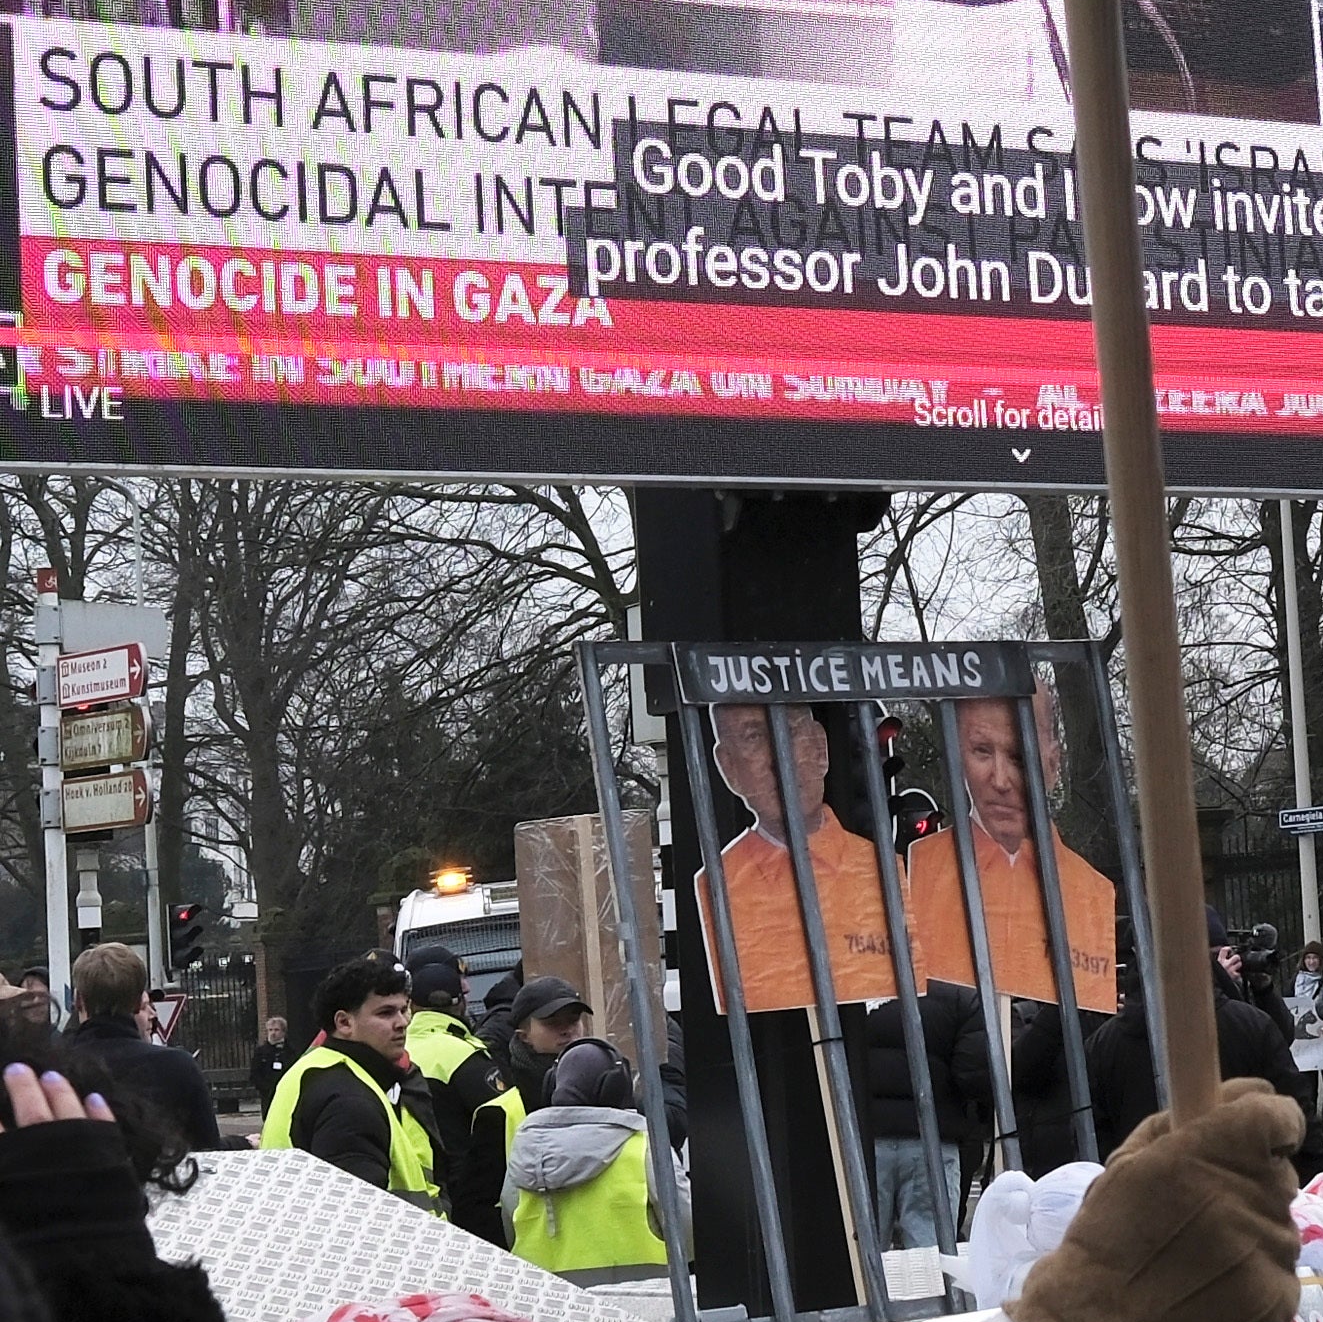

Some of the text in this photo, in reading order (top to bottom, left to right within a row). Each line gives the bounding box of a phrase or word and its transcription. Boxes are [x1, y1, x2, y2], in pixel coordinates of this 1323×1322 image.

[39, 47, 284, 127] SOUTH
[312, 70, 602, 149] AFRICAN
[628, 94, 816, 163] LEGAL
[842, 111, 1001, 179] TEAM
[1027, 126, 1168, 196] SS
[43, 144, 450, 232] GENOCIDAL
[633, 137, 785, 203] Good
[800, 150, 934, 226] Toby
[951, 164, 1045, 219] and
[1065, 167, 1076, 222] I
[1134, 185, 1198, 230] ow
[43, 248, 615, 327] GENOCIDE IN GAZA
[586, 227, 861, 297] professor
[878, 244, 1011, 303] John
[1028, 251, 1209, 313] Duard
[1223, 265, 1273, 316] to
[41, 385, 124, 419] LIVE
[914, 399, 988, 429] Scroll
[994, 399, 1030, 429] for
[71, 677, 127, 697] Kunstmuseum
[861, 651, 983, 689] MEANS
[93, 781, 123, 797] Holland
